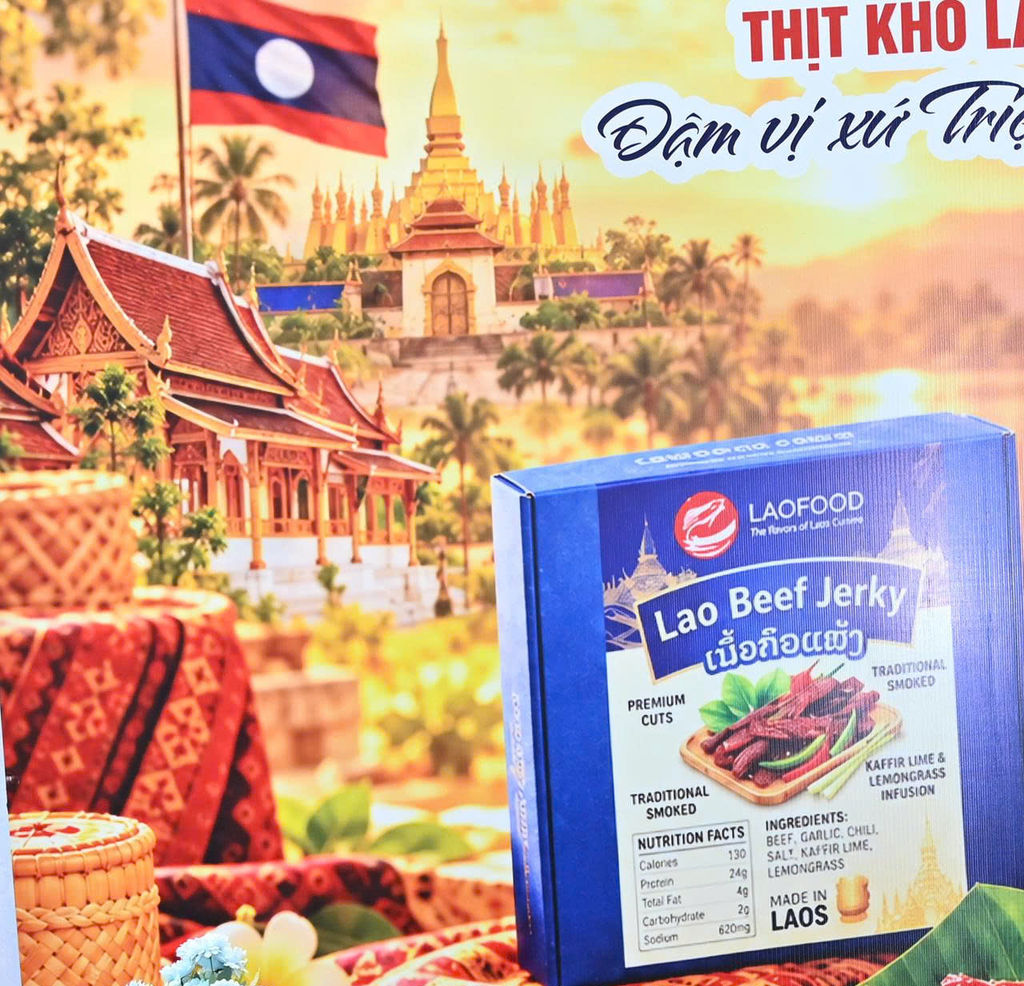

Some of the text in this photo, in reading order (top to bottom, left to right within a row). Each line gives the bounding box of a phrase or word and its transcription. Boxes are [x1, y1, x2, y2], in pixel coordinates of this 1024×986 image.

[743, 8, 848, 71] THỊT
[598, 99, 741, 168] Đậm
[761, 97, 826, 161] vị
[827, 97, 910, 152] xứ
[749, 491, 864, 523] LAOFOOD
[654, 574, 907, 642] Lao Beef Jerky
[872, 658, 947, 678] TRADITIONAL
[887, 675, 936, 692] SMOKED
[628, 694, 686, 711] PREMIUM
[641, 712, 674, 726] CUTS
[865, 752, 946, 773] KAFFIR LIME &
[869, 767, 946, 787] LEMONGRASS
[630, 785, 710, 805] TRADITIONAL
[881, 784, 935, 801] INFUSION
[646, 803, 697, 820] SMOKED
[765, 811, 849, 832] INGREDIENTS:
[637, 826, 745, 851] NUTRITION FACTS
[639, 849, 747, 872] Calories 130
[768, 858, 845, 878] LEMONGRASS
[729, 868, 748, 881] 24g
[642, 886, 749, 909] Total Fat 4g
[770, 889, 827, 907] MADE IN
[642, 909, 706, 928] Carbohydrate
[771, 904, 829, 931] LAOS
[643, 922, 751, 946] Sodium 620mg
